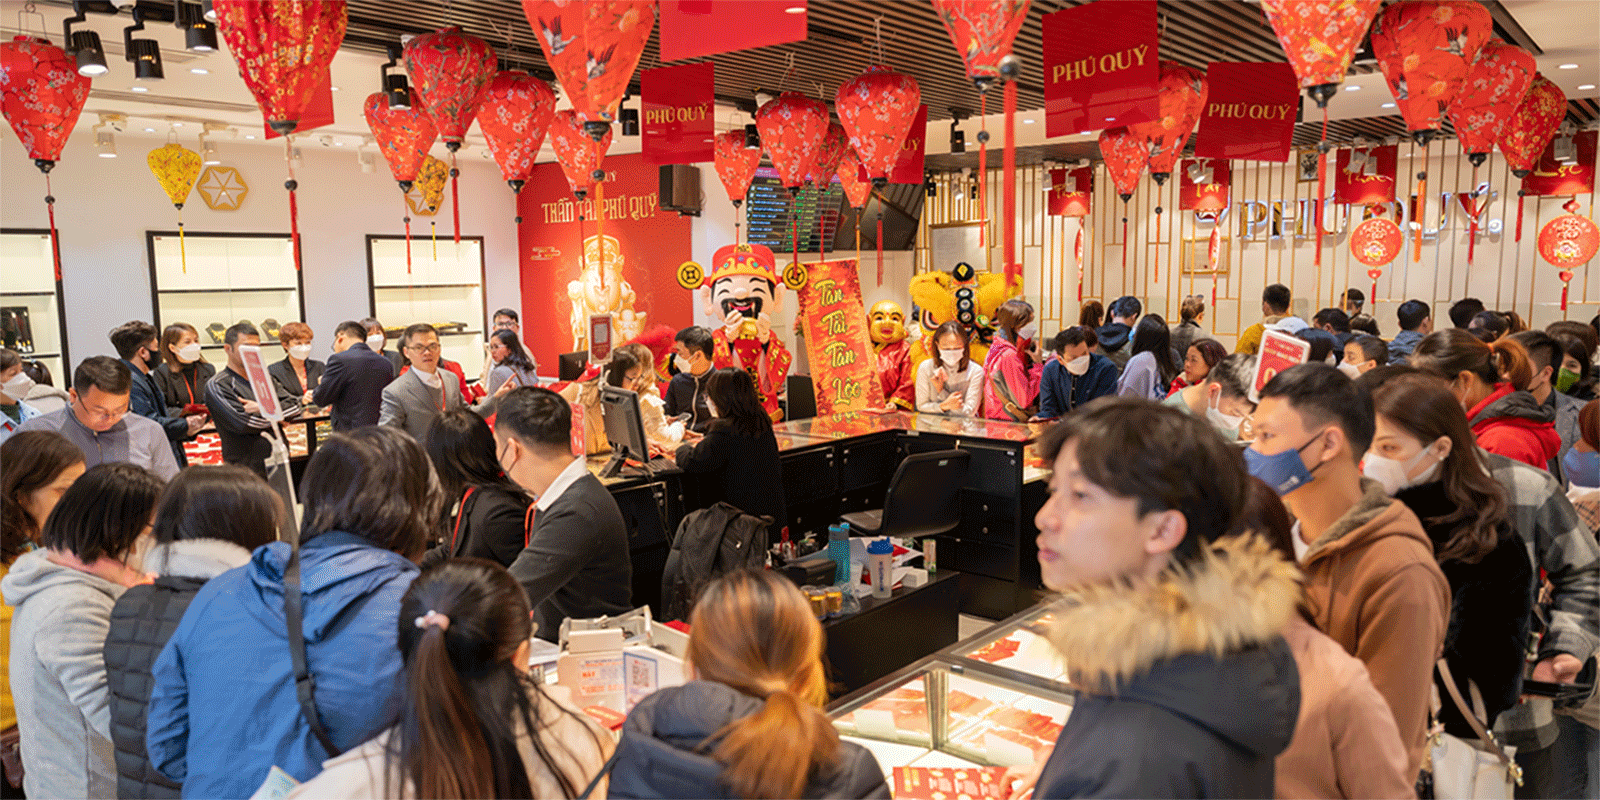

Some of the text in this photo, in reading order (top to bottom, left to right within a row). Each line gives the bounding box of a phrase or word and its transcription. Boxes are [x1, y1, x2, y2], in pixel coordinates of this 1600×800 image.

[1052, 43, 1148, 84] PHÚ QUÝ
[646, 103, 708, 125] PHÚ QUÝ
[1208, 102, 1291, 120] PHÚ QUÝ
